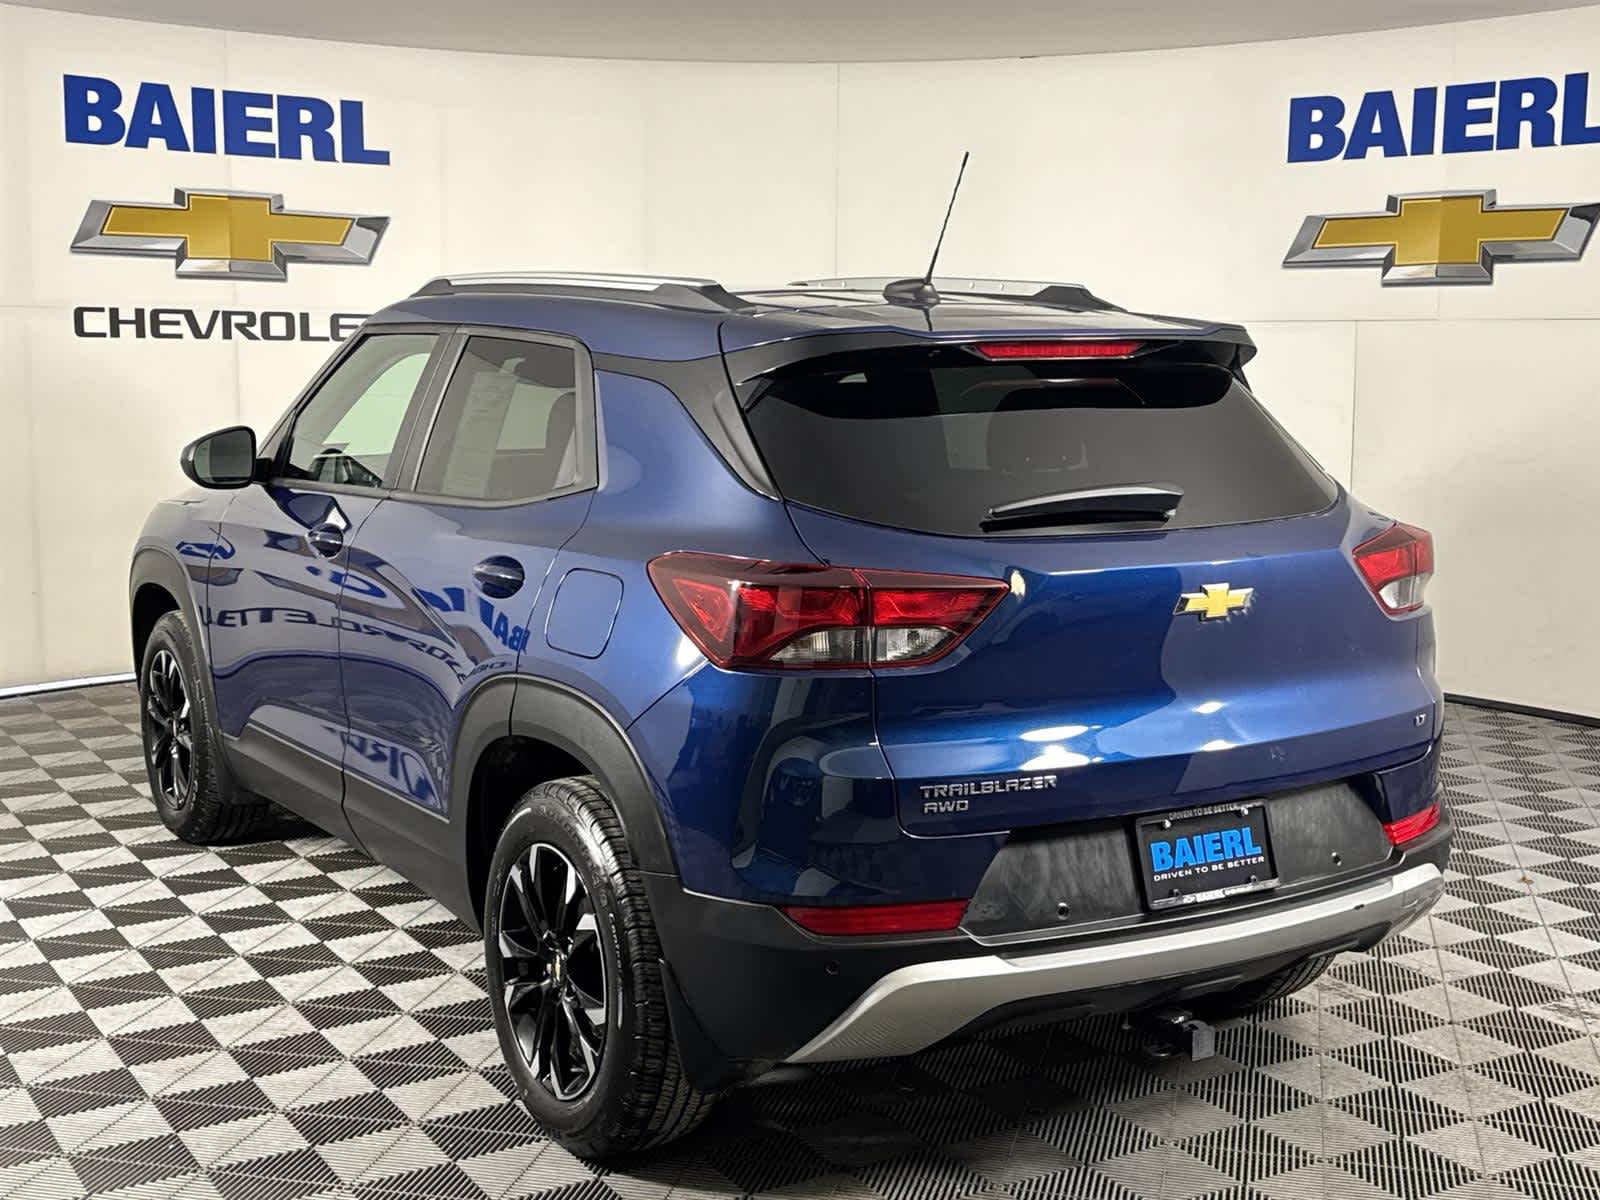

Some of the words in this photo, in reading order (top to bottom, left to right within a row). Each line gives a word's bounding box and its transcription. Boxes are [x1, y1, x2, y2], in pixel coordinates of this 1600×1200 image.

[63, 73, 390, 165] BAIERL
[1287, 71, 1600, 163] BAIERL
[73, 306, 371, 342] CHEVROLE
[920, 775, 1057, 799] TRAILBLAZER
[923, 800, 969, 814] AWD
[1150, 826, 1262, 873] BAIERL
[1153, 869, 1192, 882] DRIVEN
[1196, 865, 1208, 873] TO
[1211, 862, 1225, 871] BE
[1227, 856, 1265, 869] BETTER
